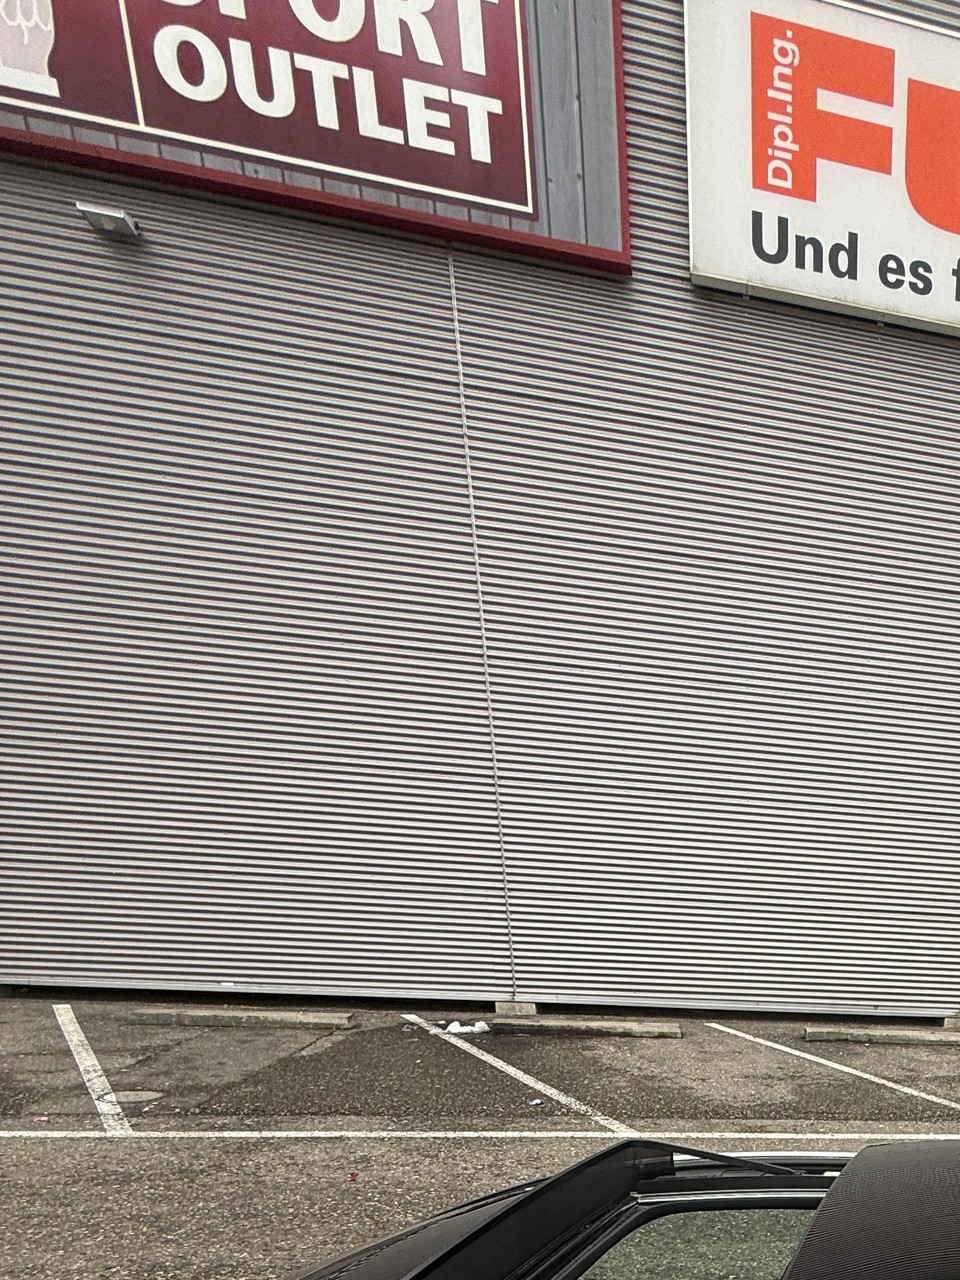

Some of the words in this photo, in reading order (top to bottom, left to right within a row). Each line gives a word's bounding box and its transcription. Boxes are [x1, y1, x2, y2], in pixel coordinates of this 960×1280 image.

[153, 24, 503, 164] OUTLET
[767, 29, 800, 190] Dipl.Ing.
[750, 210, 859, 281] Und
[878, 246, 934, 297] es
